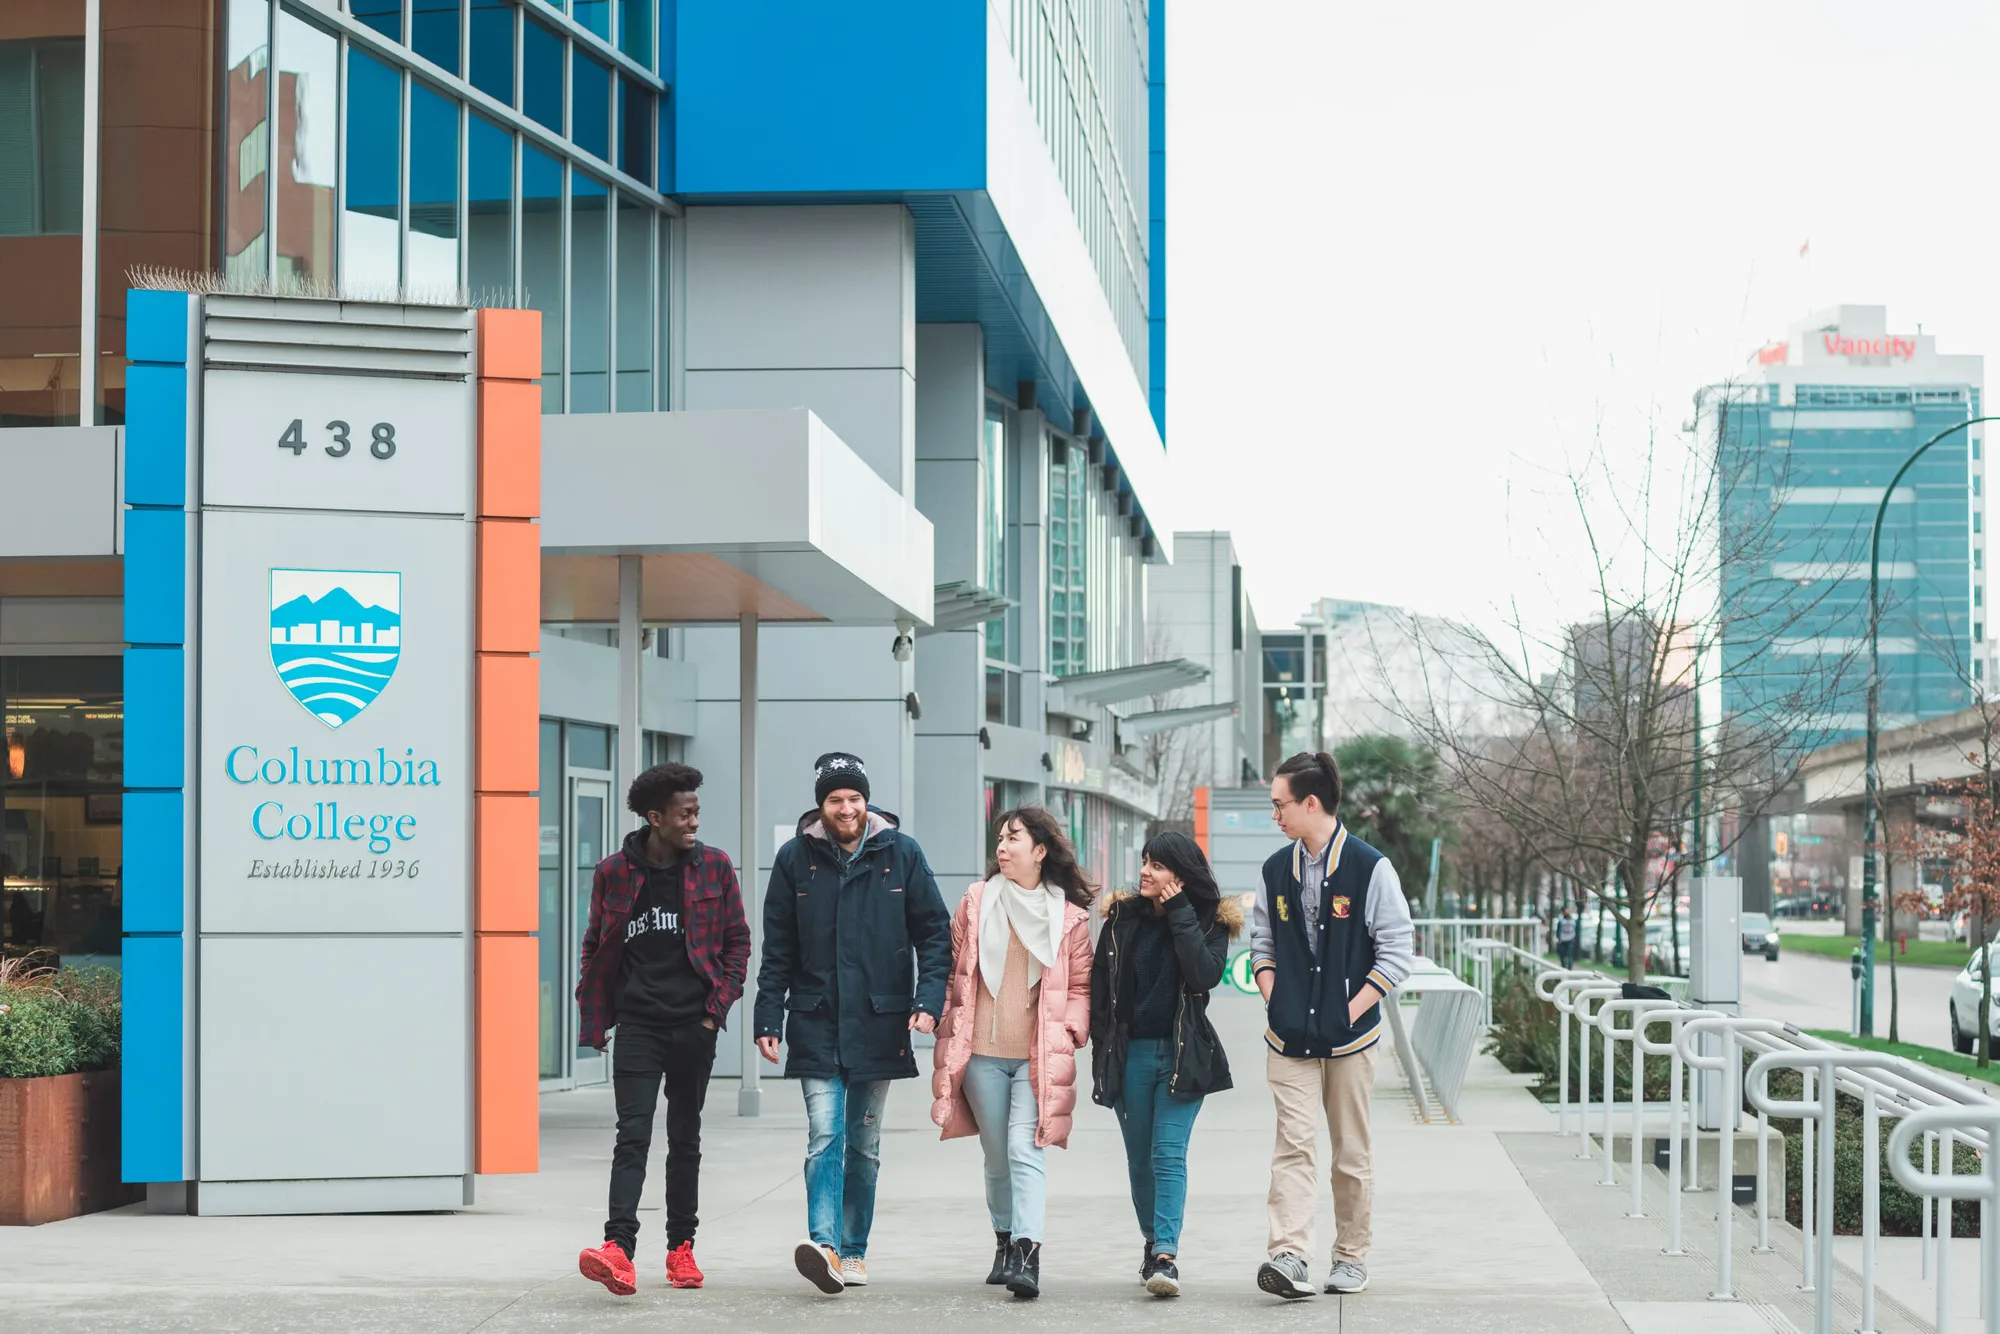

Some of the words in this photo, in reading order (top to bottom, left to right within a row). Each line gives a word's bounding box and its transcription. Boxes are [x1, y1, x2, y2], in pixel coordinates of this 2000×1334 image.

[1823, 333, 1917, 362] Vancity
[278, 418, 397, 460] 438
[225, 745, 441, 786] Columbia
[251, 801, 417, 854] College
[247, 859, 362, 879] Established
[366, 859, 420, 879] 1936
[624, 911, 648, 943] os
